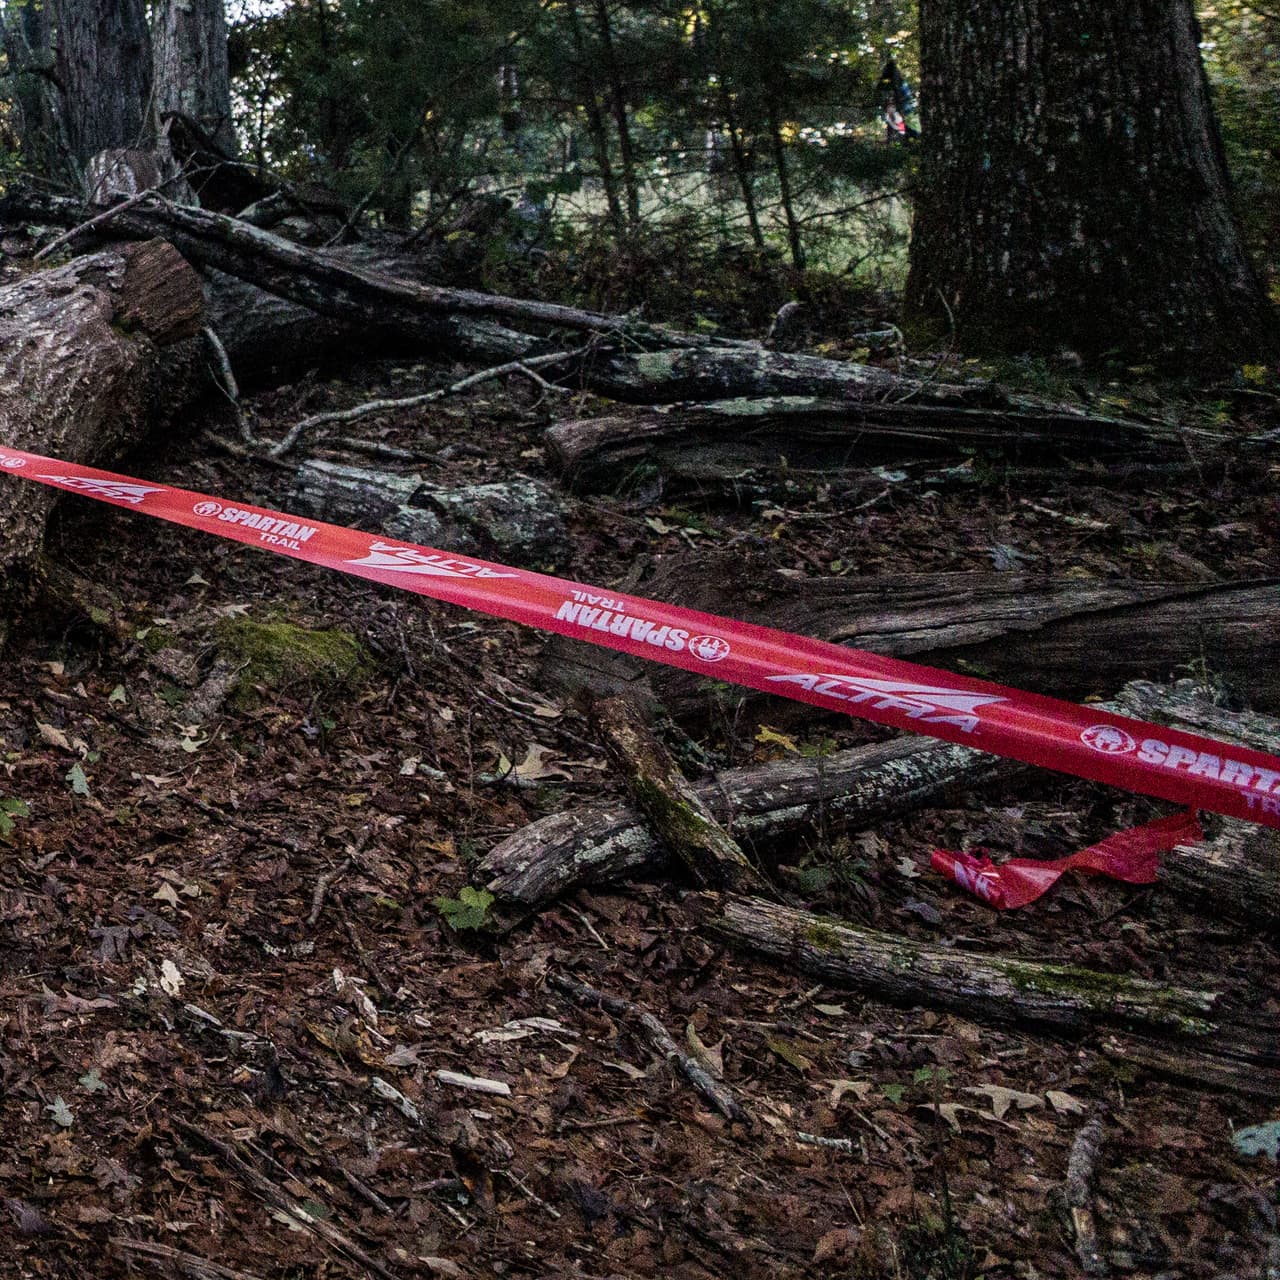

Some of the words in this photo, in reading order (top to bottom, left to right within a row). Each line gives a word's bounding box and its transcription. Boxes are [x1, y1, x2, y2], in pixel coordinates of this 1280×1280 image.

[35, 475, 145, 504] ALTRA
[218, 507, 316, 542] SPARTAN
[260, 532, 300, 551] TRAIL
[368, 540, 521, 578] ALTRA
[571, 589, 625, 613] TRAIL
[555, 600, 689, 651] SPARTAN
[764, 673, 981, 734] ALTRA
[1137, 738, 1280, 796] SPART
